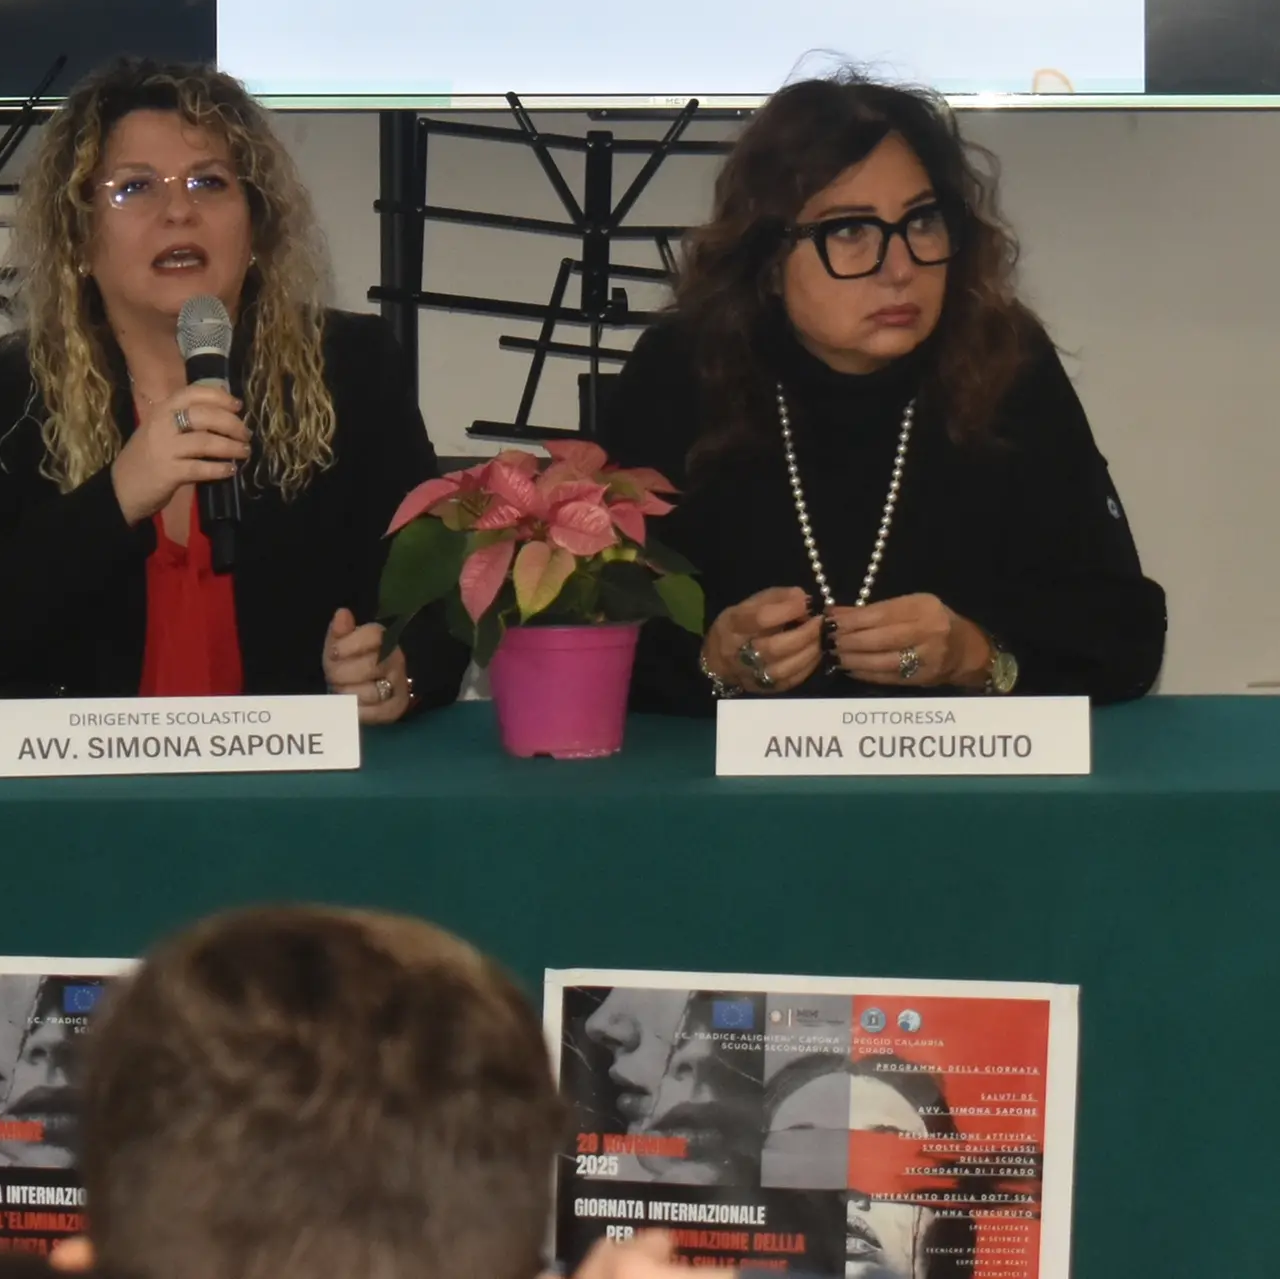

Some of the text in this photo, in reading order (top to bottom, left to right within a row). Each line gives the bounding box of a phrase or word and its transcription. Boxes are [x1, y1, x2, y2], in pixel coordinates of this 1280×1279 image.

[69, 710, 272, 727] DIRIGENTE SCOLASTICO
[842, 711, 956, 725] DOTTORESSA
[18, 733, 325, 761] AVV. SIMONA SAPONE
[764, 734, 1033, 758] ANNA CURCURUTO
[876, 1062, 943, 1072] PROGRAMMA
[984, 1066, 1039, 1074] GIORNATA
[949, 1106, 991, 1115] SIMONA
[995, 1107, 1038, 1116] SAPONE
[575, 1154, 619, 1175] 2025
[6, 1185, 88, 1206] INTERNAZIO
[943, 1193, 976, 1202] DELLA
[574, 1198, 767, 1225] GIORNATA INTERNAZIONALE
[934, 1210, 1034, 1218] ANNA CURCURUTO
[606, 1225, 634, 1245] PER
